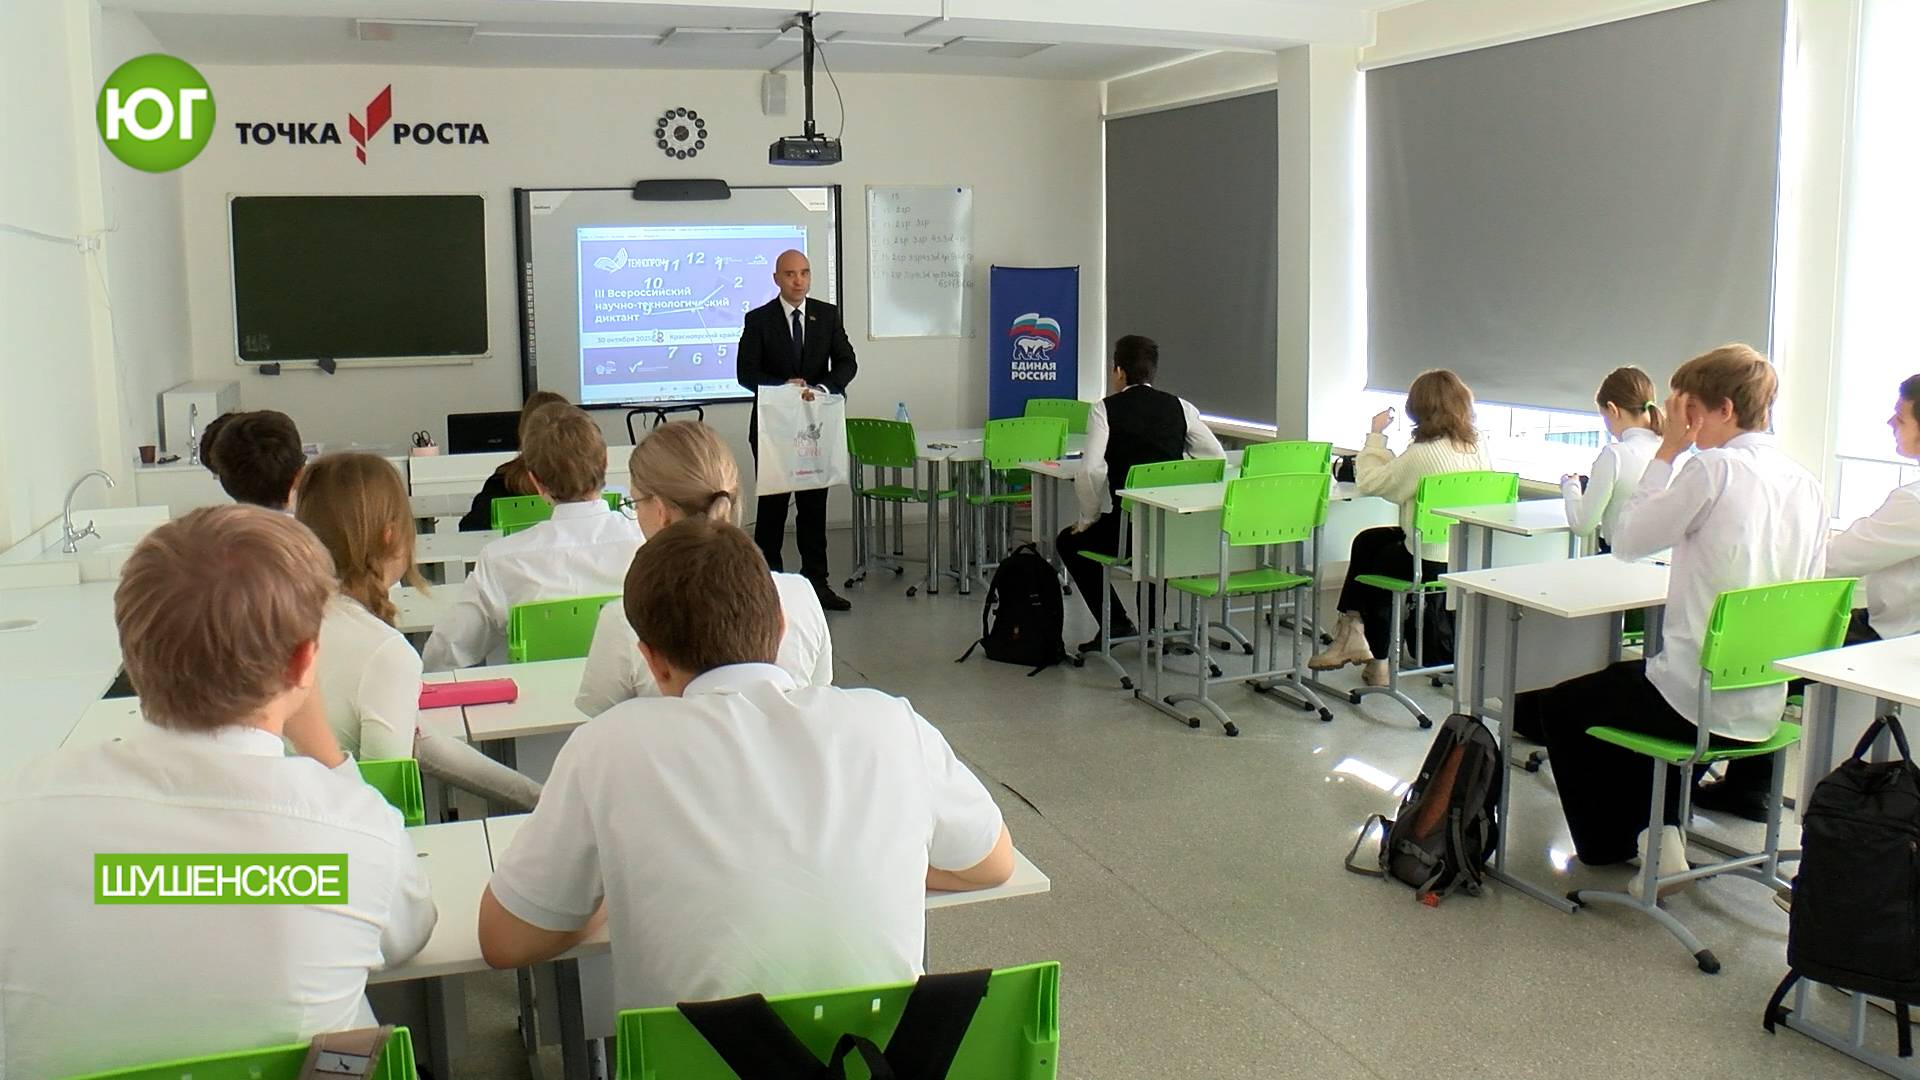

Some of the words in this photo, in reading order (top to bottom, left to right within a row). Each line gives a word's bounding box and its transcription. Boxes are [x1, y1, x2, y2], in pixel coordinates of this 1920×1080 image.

[235, 122, 341, 145] ТОЧКА
[394, 123, 490, 145] РОСТА
[687, 252, 705, 265] 12
[644, 277, 663, 290] 10
[734, 276, 744, 289] 2
[607, 286, 692, 299] Всероссийский
[595, 298, 730, 312] научно-тхнологичский
[595, 314, 640, 324] диктант
[668, 346, 678, 359] 7
[717, 344, 727, 357] 5
[692, 352, 702, 365] 6
[1011, 361, 1057, 371] ЕДИНАЯ
[1011, 371, 1057, 381] РОССИЯ
